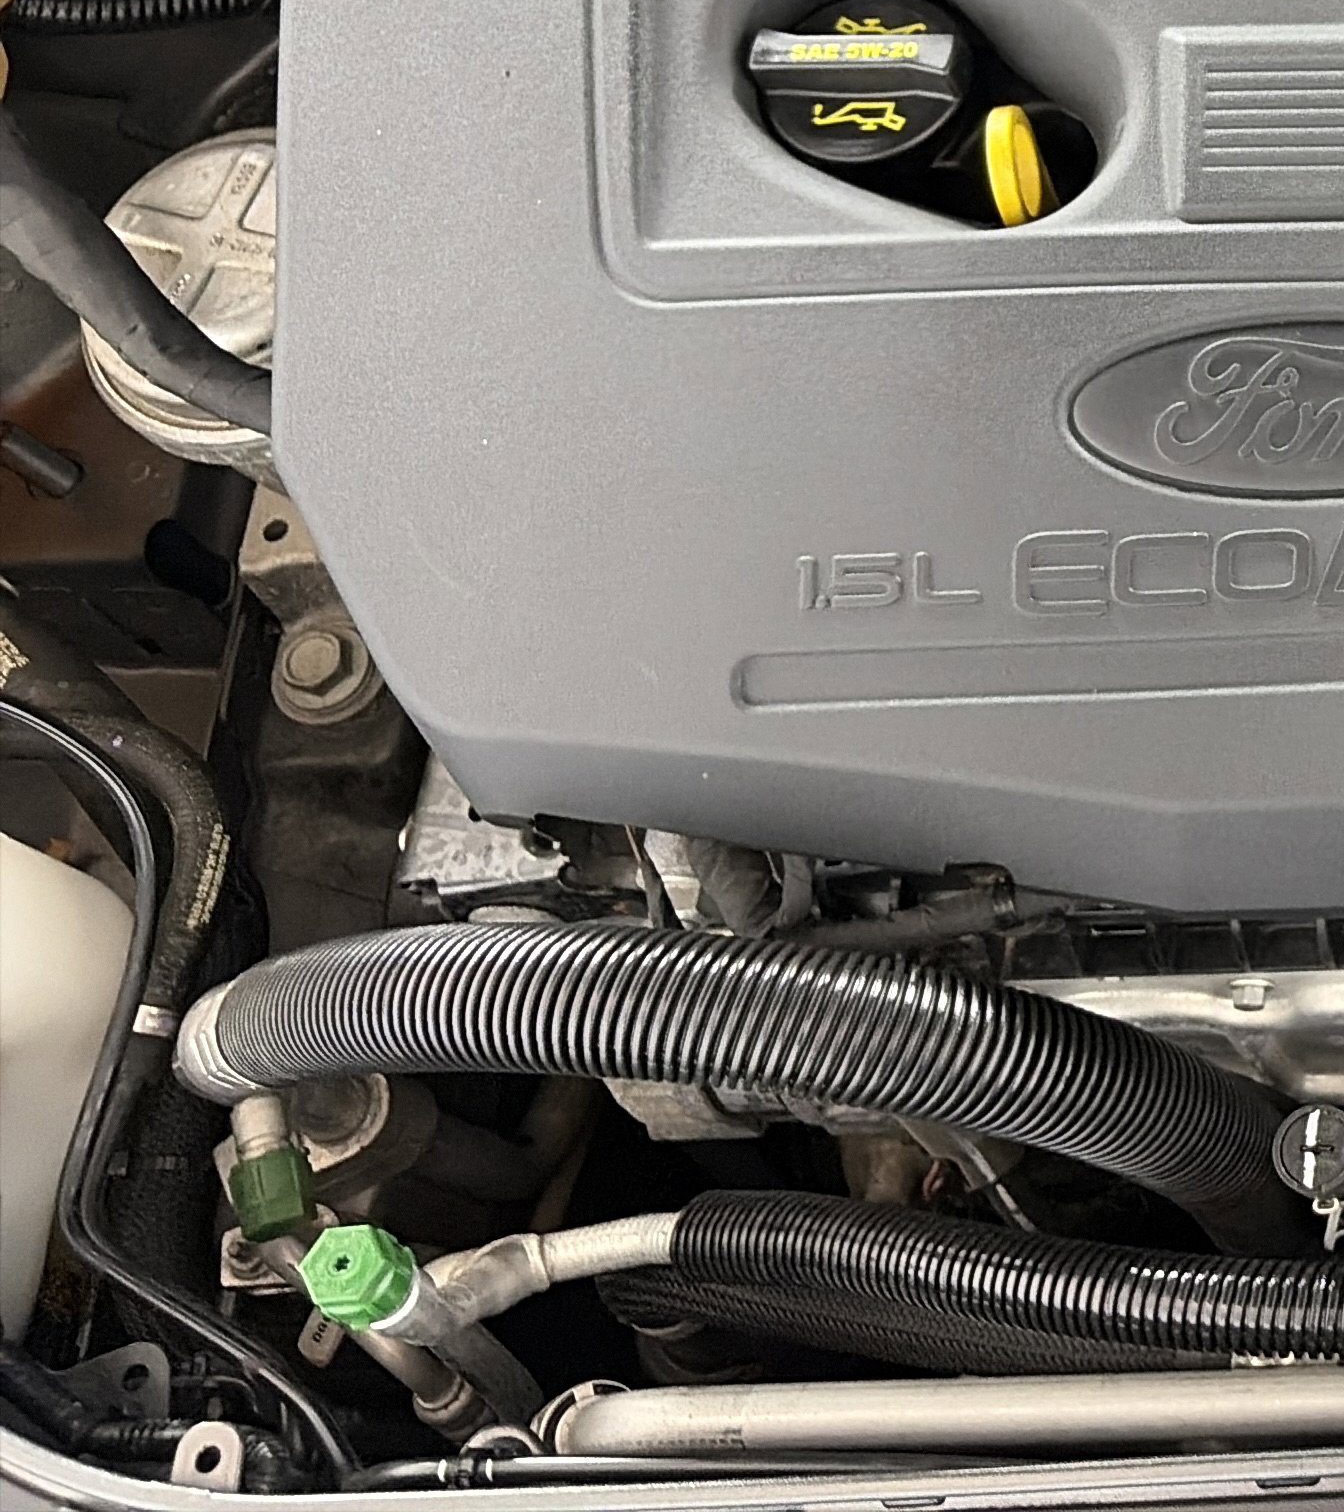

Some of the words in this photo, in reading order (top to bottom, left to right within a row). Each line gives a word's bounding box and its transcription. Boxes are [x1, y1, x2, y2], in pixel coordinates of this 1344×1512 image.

[790, 43, 840, 61] SAE
[845, 41, 920, 59] 5W-20
[796, 550, 985, 613] 1.5L
